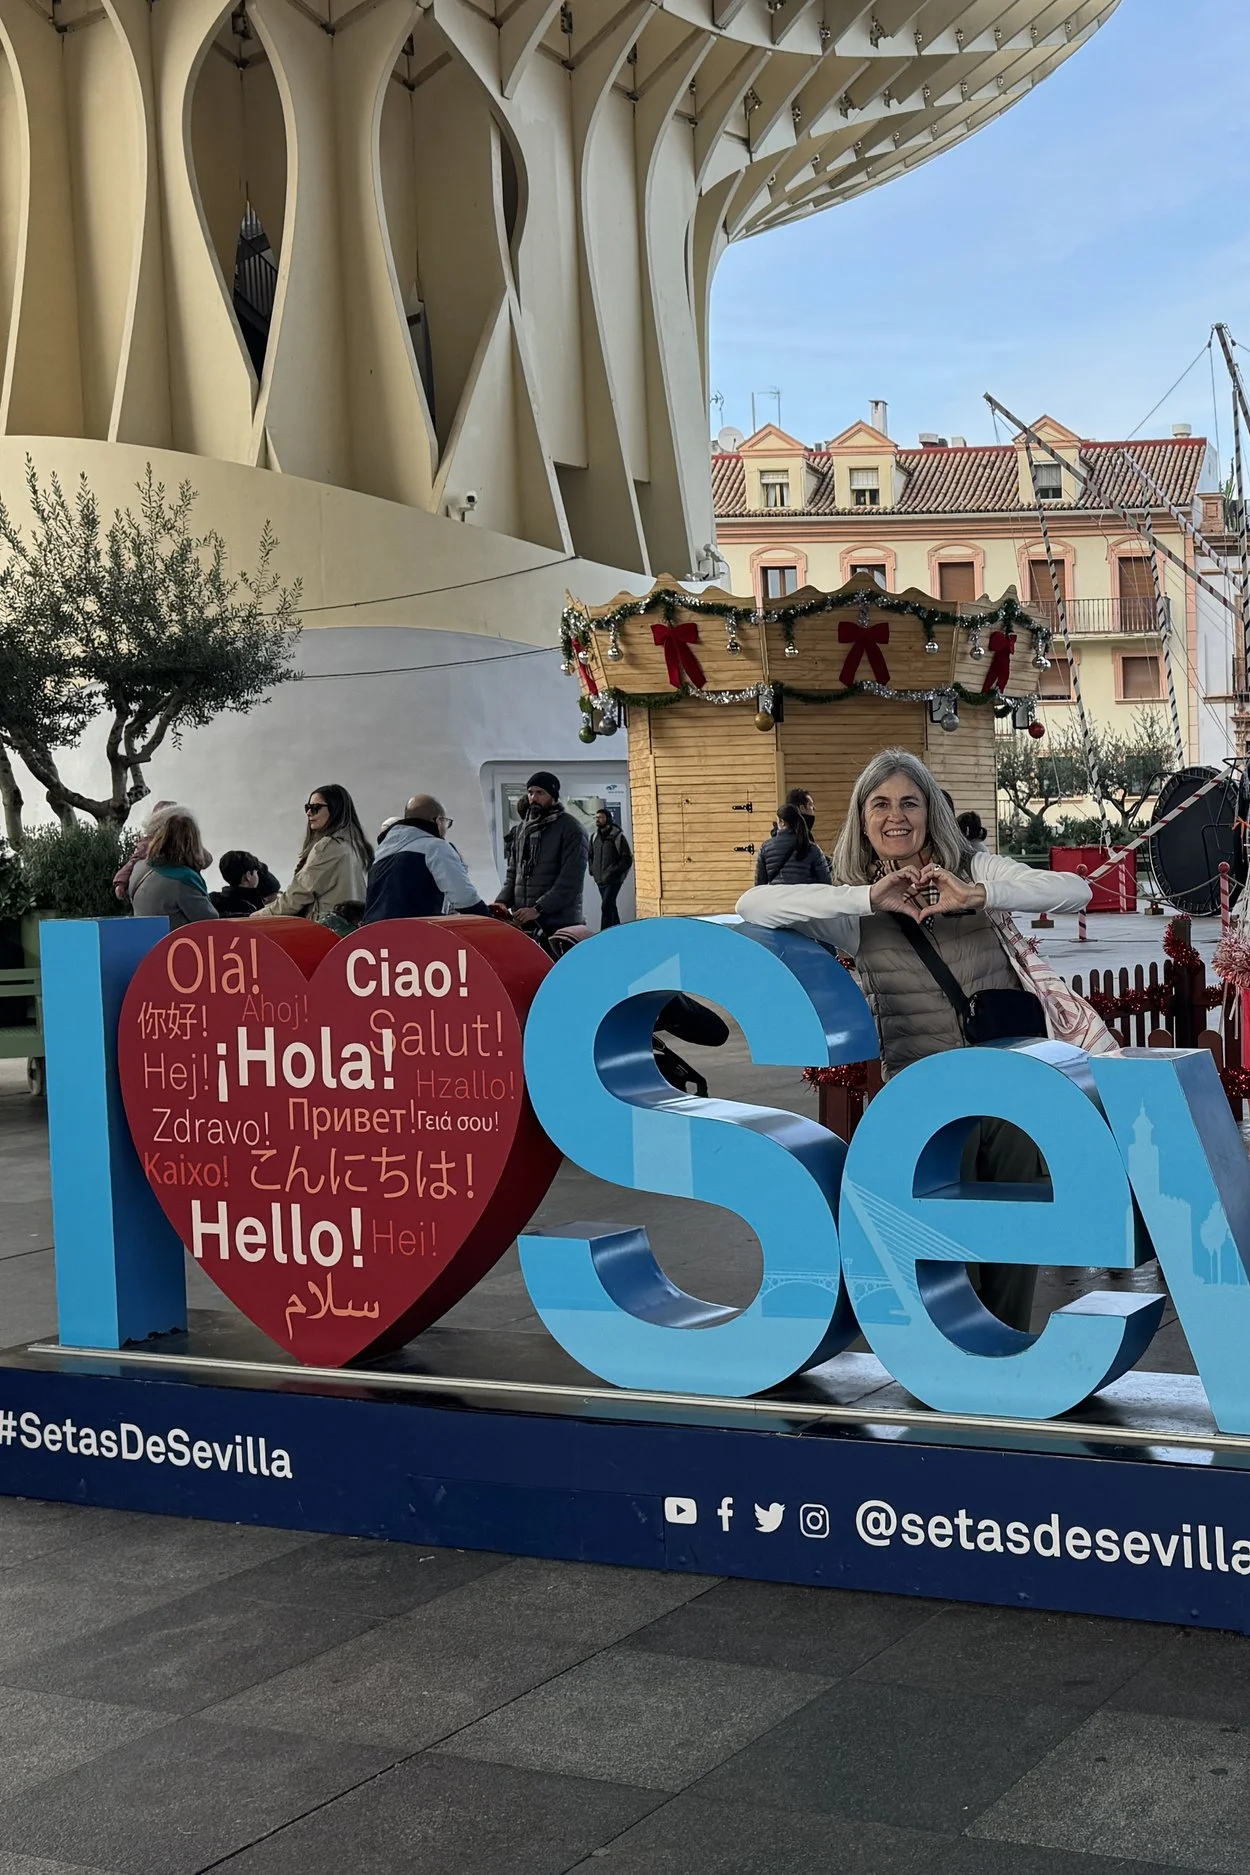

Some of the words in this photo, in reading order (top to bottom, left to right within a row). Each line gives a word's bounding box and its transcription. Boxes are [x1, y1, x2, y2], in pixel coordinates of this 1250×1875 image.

[166, 935, 261, 995] Olá!
[346, 948, 470, 998] Ciao!
[137, 1001, 208, 1041] 你好!
[241, 994, 308, 1031] Ahoj!
[369, 1008, 504, 1058] Salut!
[143, 1052, 209, 1100] Hej!
[216, 1025, 395, 1103] ¡Hola!
[416, 1069, 516, 1101] Hzallo!
[152, 1108, 271, 1147] Zdravo!
[288, 1097, 416, 1140] Привет!
[417, 1109, 453, 1132] Γειά
[456, 1111, 500, 1132] σου!
[143, 1151, 229, 1189] Kaixo!
[191, 1199, 364, 1268] Hello!
[371, 1218, 438, 1257] Hei!
[284, 1271, 380, 1340] سلام
[0, 1409, 293, 1480] #SetasDeSevilla
